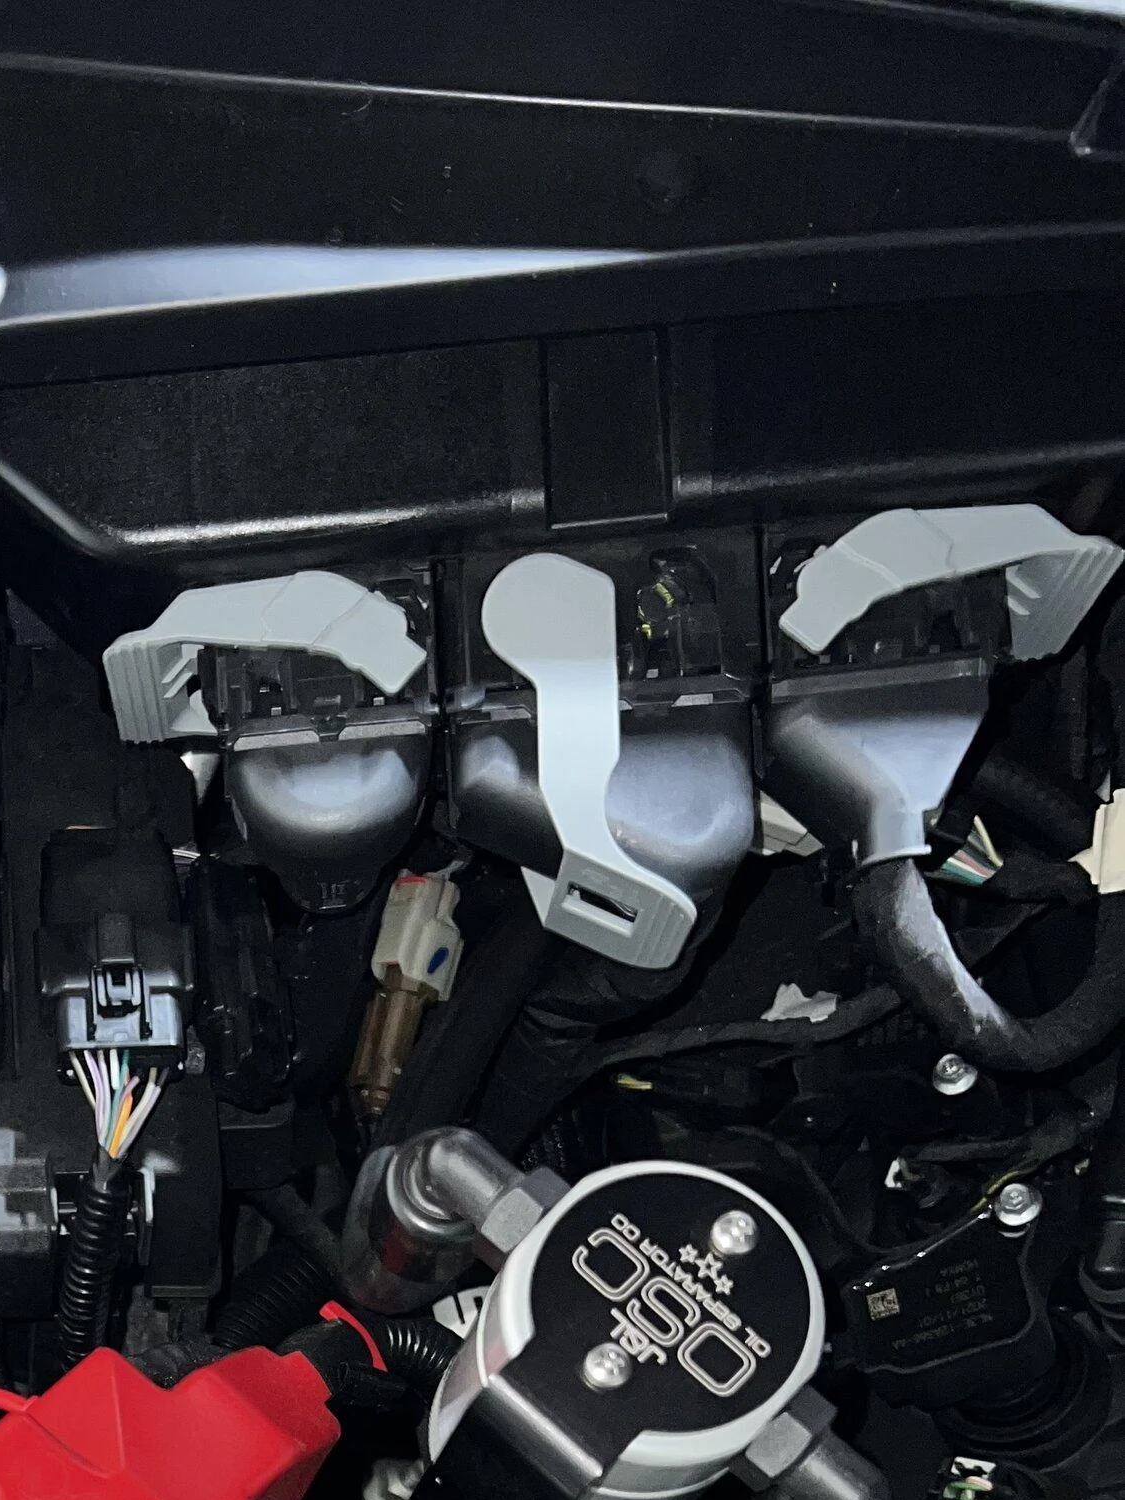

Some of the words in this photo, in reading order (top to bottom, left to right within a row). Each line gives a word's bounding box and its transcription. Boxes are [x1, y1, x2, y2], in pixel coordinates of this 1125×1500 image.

[610, 1213, 642, 1243] CO
[639, 1238, 743, 1332] SEPARATOR
[743, 1326, 773, 1359] OIL
